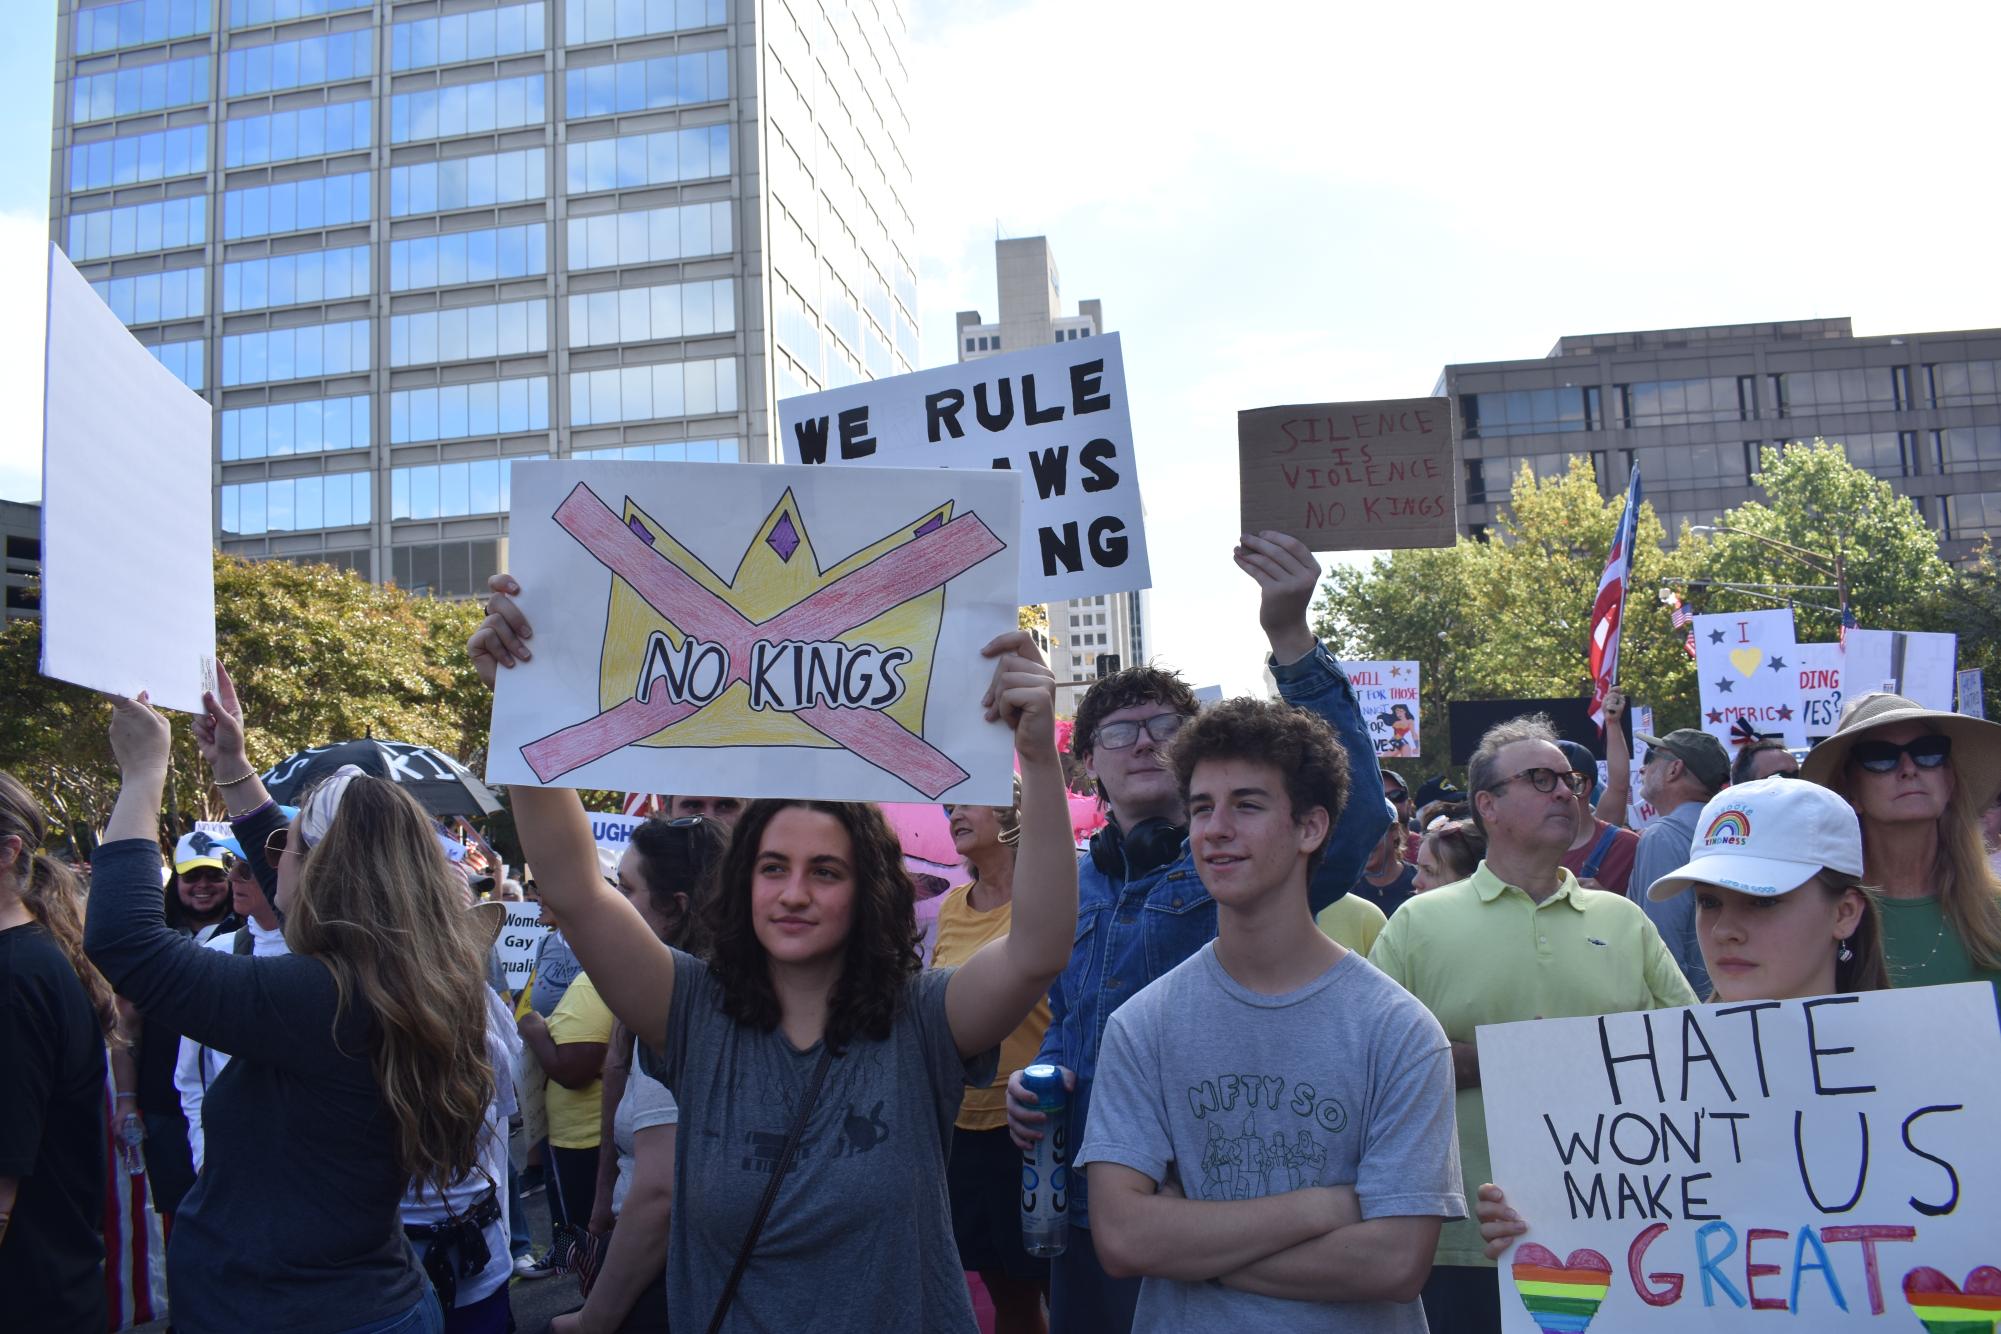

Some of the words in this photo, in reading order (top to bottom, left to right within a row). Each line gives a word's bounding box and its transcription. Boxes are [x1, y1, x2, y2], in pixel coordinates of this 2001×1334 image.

[795, 406, 877, 464] WE
[925, 359, 1111, 443] RULE
[1272, 410, 1433, 454] SILENCE
[1281, 458, 1442, 489] VIOLENCE
[1332, 444, 1373, 466] IS
[1306, 501, 1346, 529] NO
[1363, 496, 1446, 523] KINGS
[1737, 622, 1750, 643] I
[641, 637, 726, 702] NO
[753, 644, 905, 707] KINGS
[1389, 687, 1418, 700] THOSE
[504, 913, 551, 928] Wome
[505, 936, 534, 951] Gay
[1598, 997, 1877, 1105] HATE
[1188, 1074, 1285, 1119] NFTY
[1291, 1083, 1348, 1133] SO
[1543, 1107, 1750, 1166] WON'T
[1794, 1104, 1963, 1217] US
[1563, 1171, 1722, 1222] MAKE
[1628, 1220, 1917, 1317] GREAT
